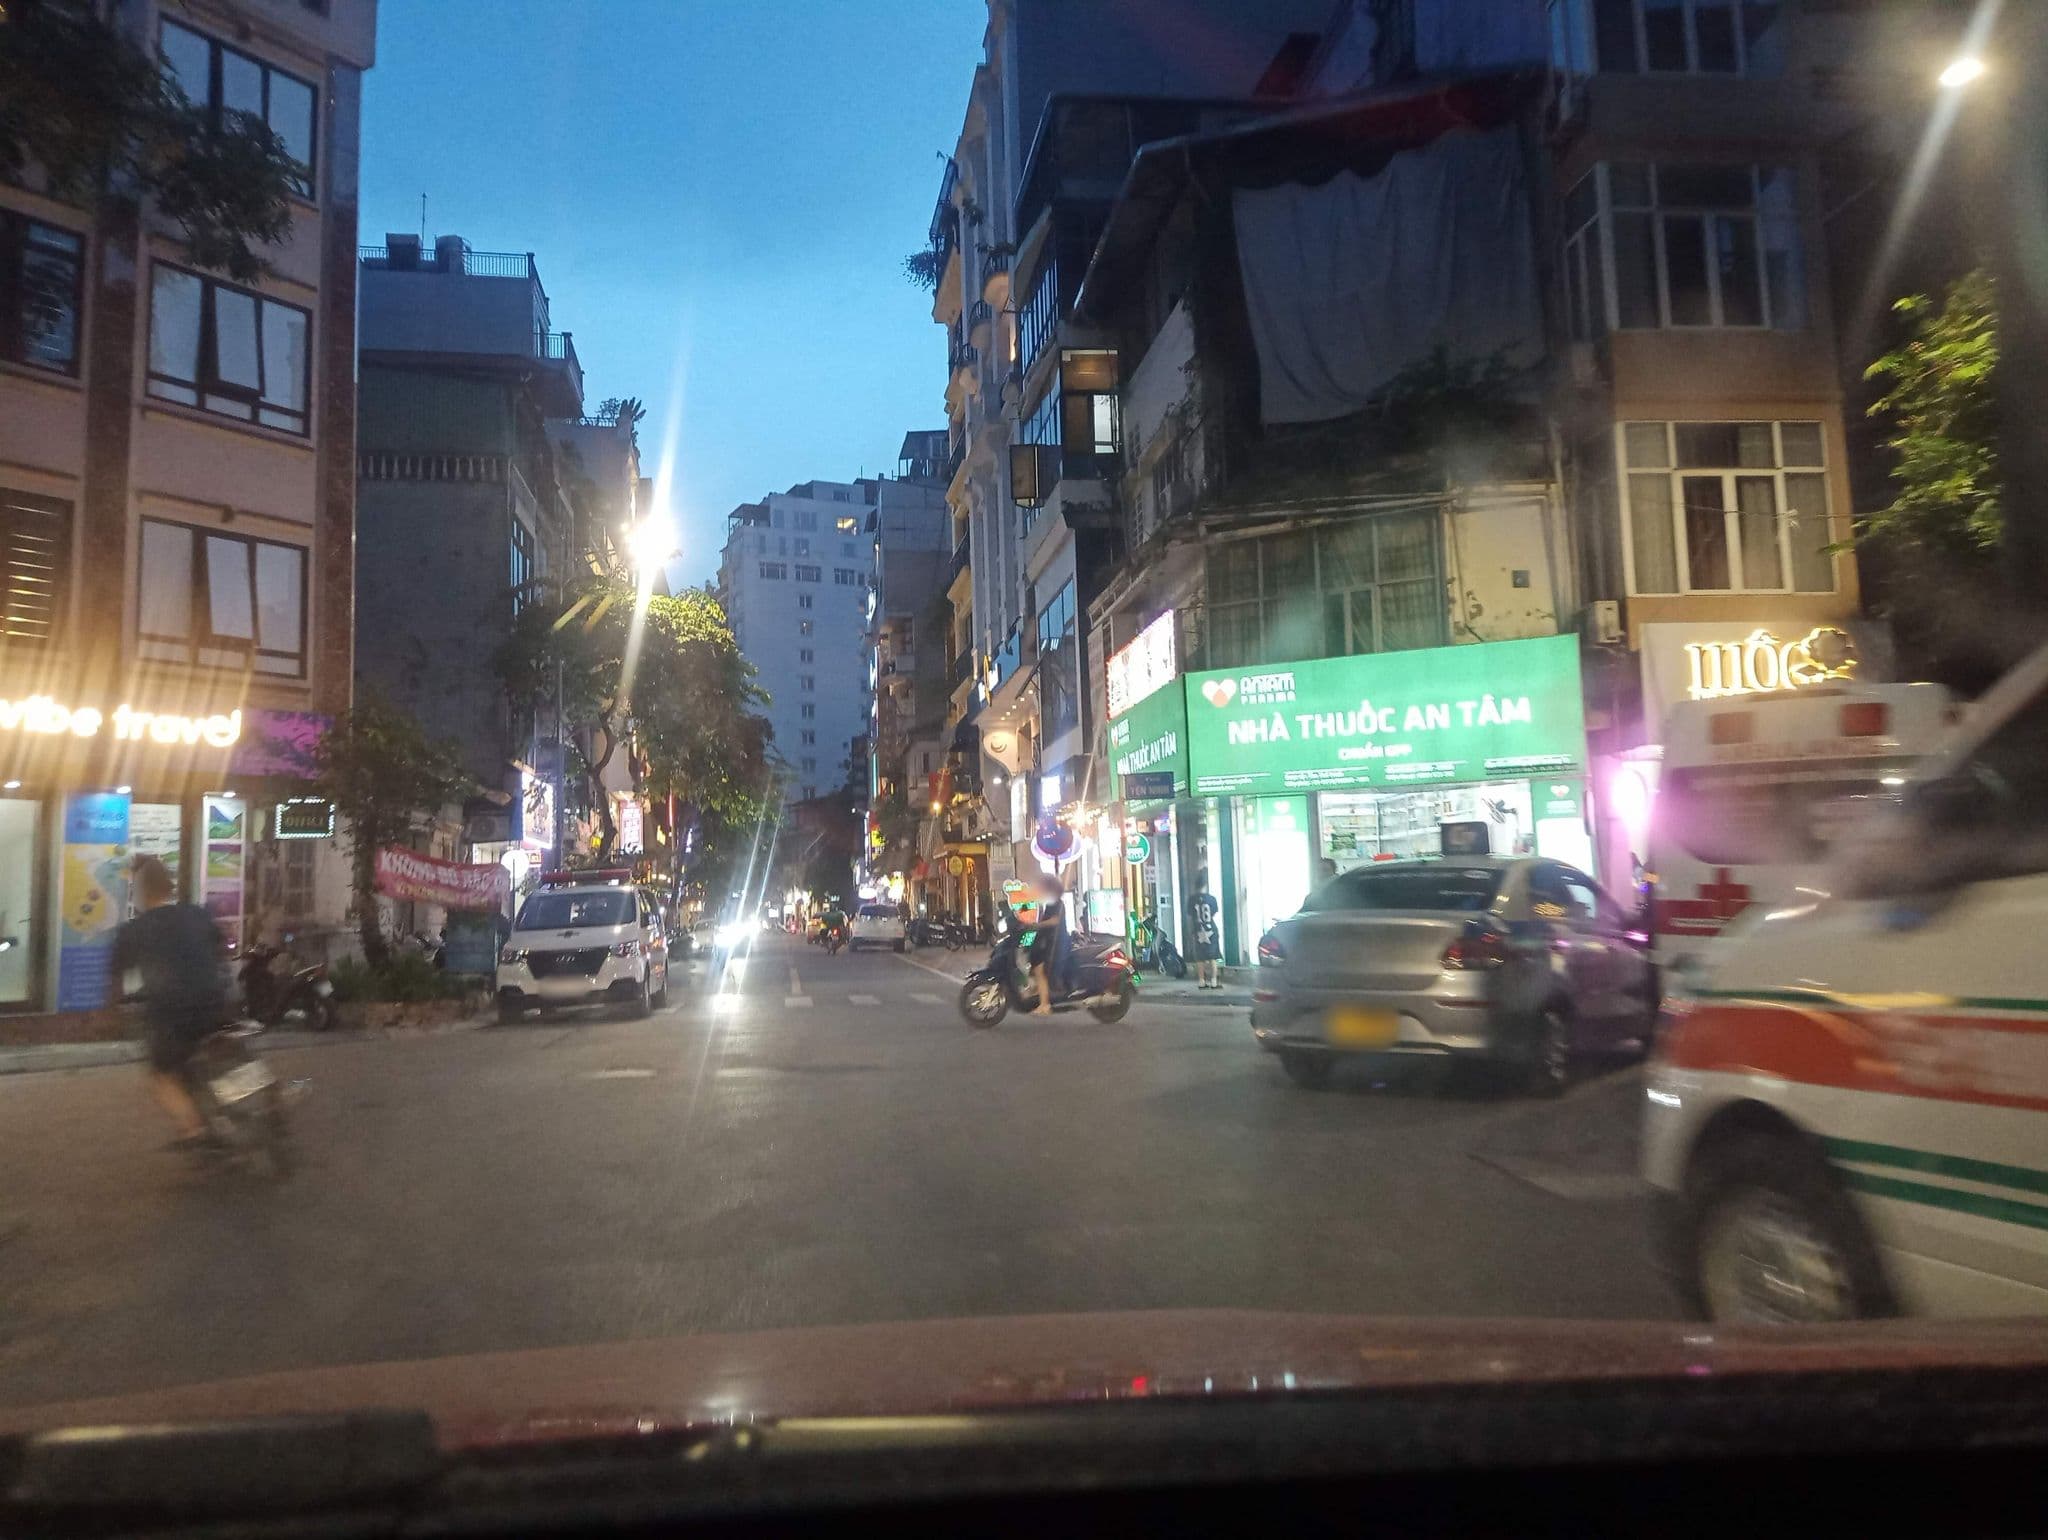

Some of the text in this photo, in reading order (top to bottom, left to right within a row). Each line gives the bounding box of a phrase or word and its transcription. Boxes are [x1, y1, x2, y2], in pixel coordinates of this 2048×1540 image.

[112, 702, 243, 748] travel
[1228, 693, 1533, 745] NHÀ THUỐC AN TÂM
